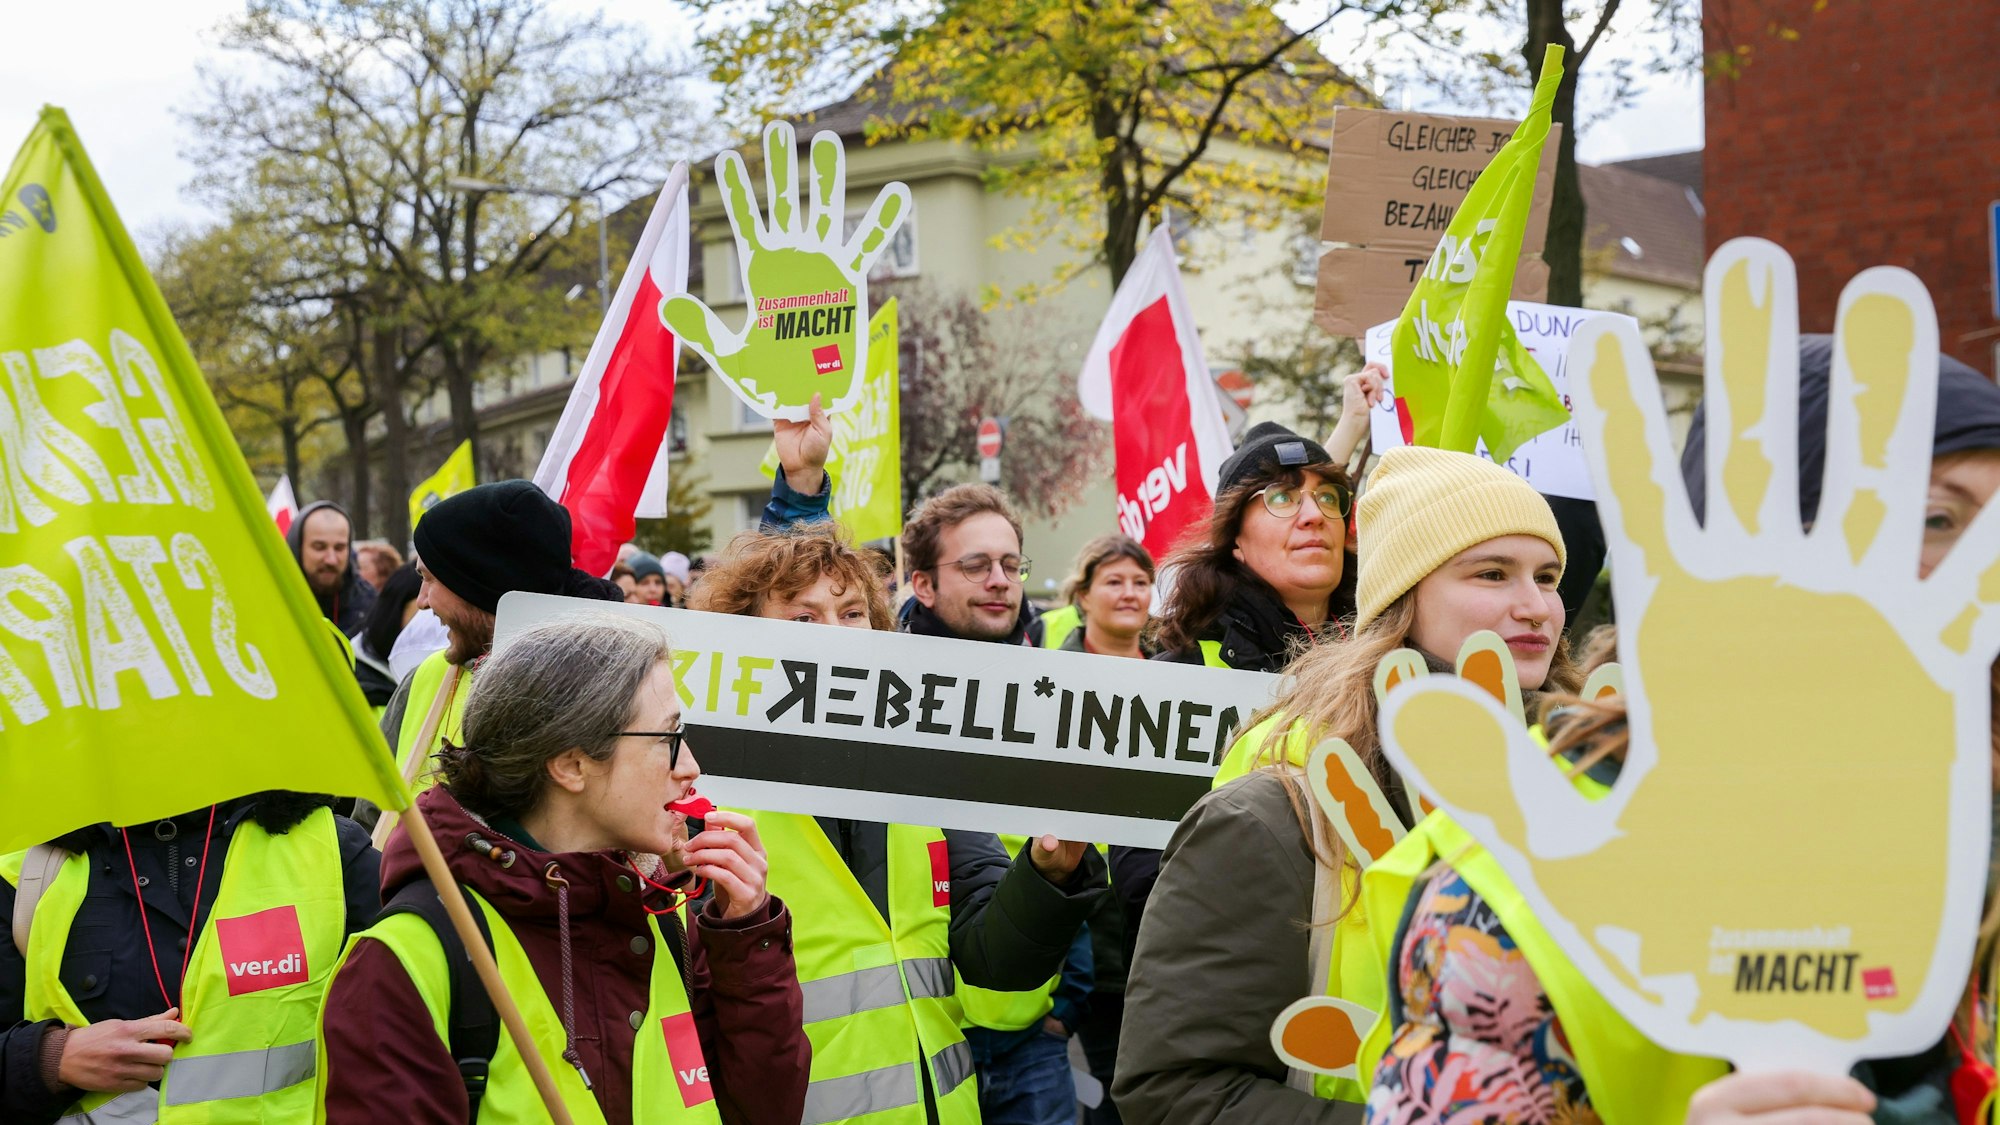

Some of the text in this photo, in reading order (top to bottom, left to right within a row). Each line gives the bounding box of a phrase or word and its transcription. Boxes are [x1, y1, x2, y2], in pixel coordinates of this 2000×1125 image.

[1387, 121, 1477, 152] GLEICHER
[1413, 166, 1483, 191] GLEICH
[1404, 258, 1427, 282] T
[758, 288, 849, 312] Zusammenhalt
[758, 313, 774, 329] ist
[775, 305, 856, 341] MACHT
[229, 953, 301, 977] ver.di
[1735, 953, 1860, 993] MACHT
